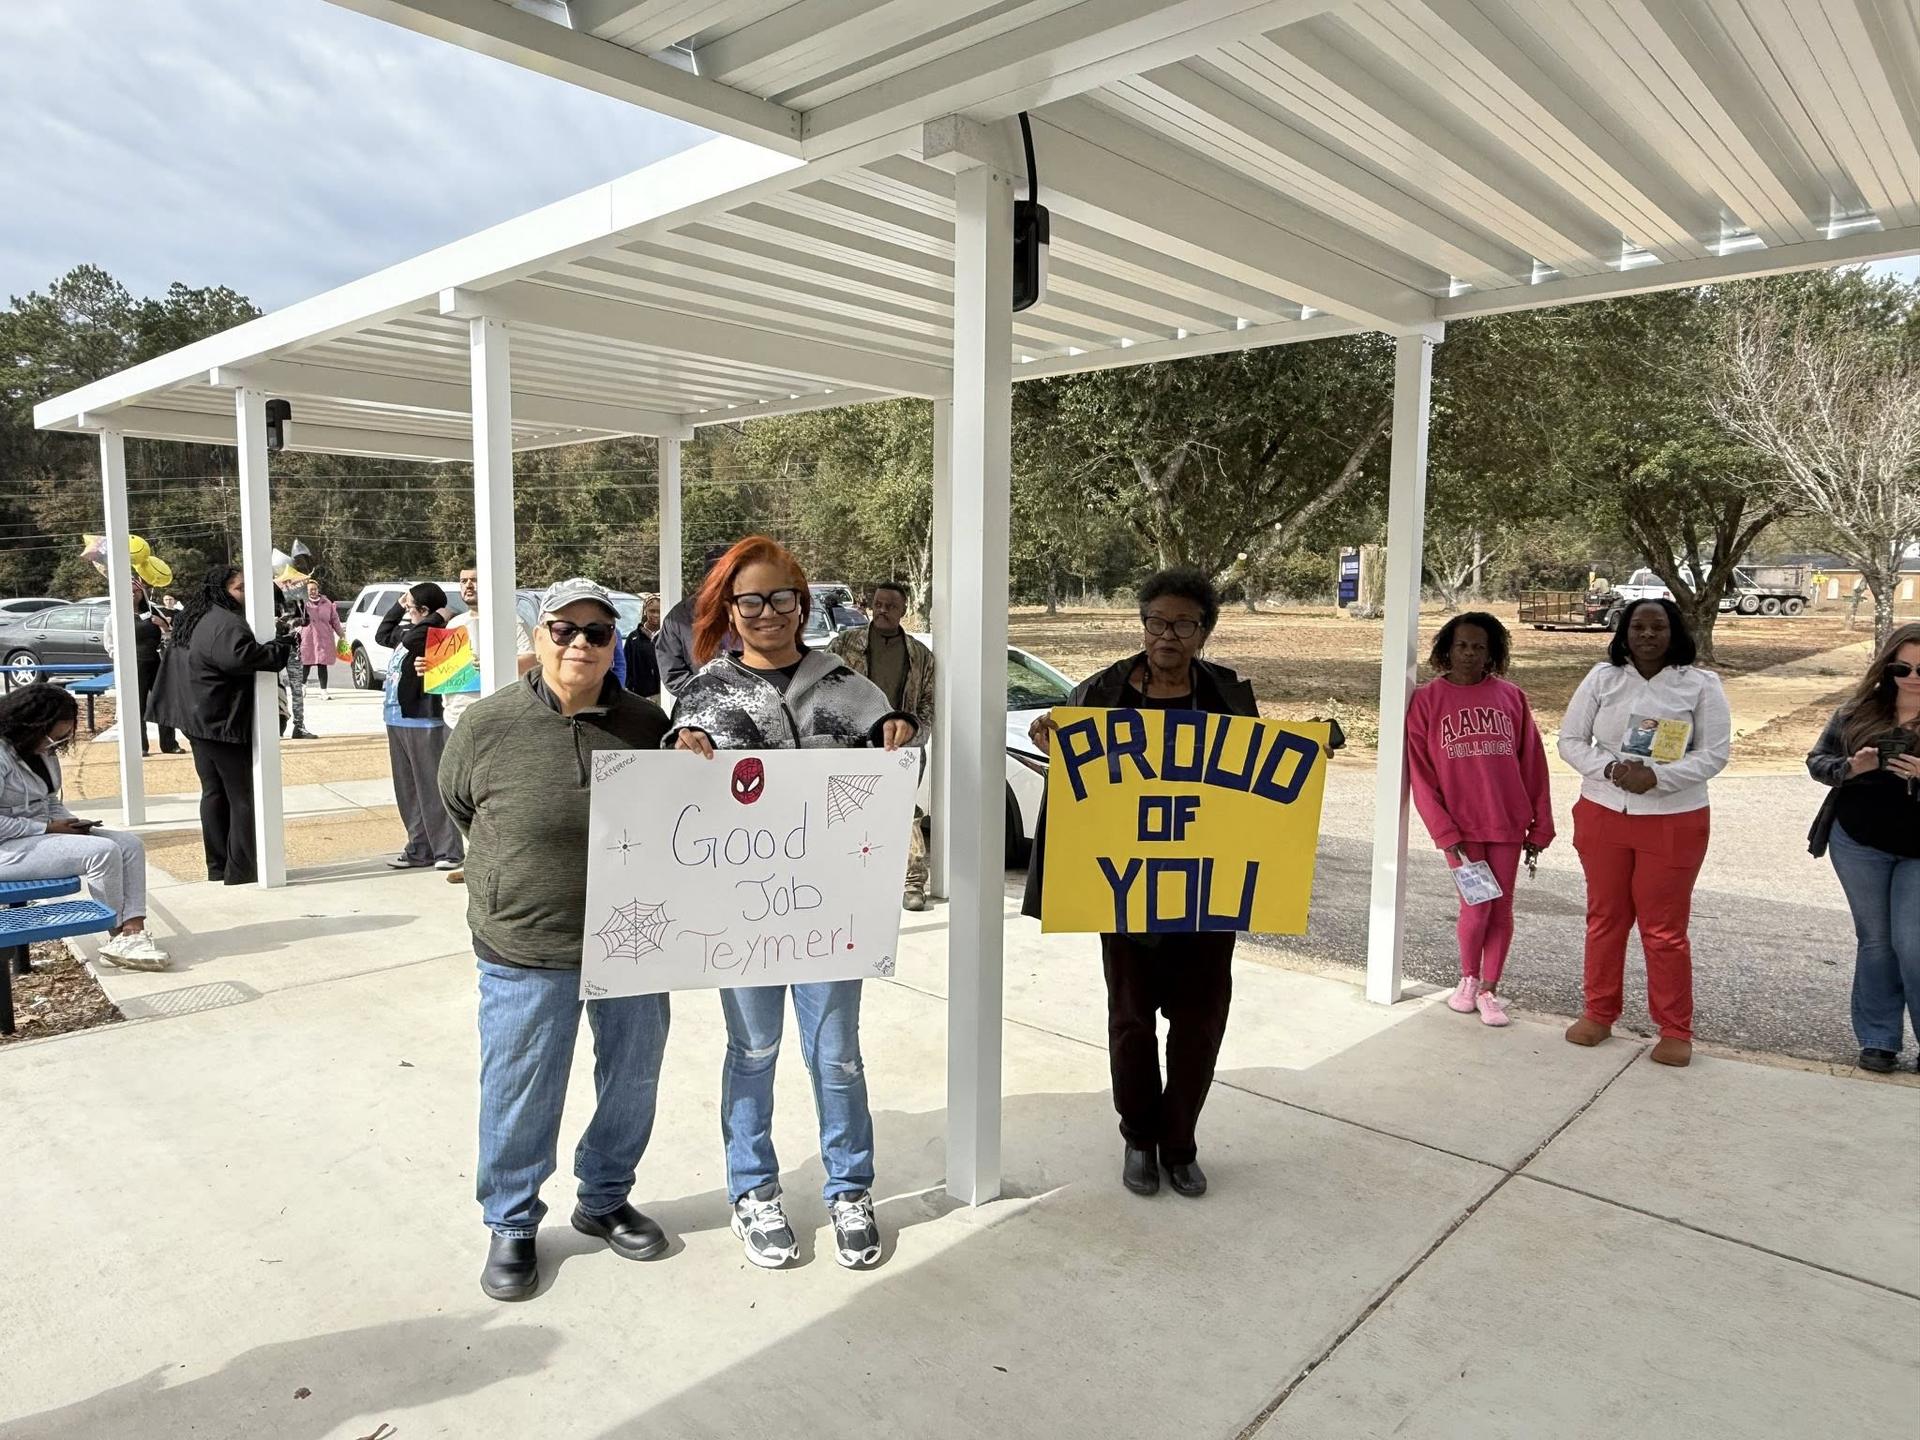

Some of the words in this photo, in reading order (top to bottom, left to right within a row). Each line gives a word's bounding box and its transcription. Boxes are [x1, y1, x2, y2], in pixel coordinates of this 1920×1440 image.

[1057, 708, 1320, 804] PROUD
[1441, 707, 1513, 748] AAMU
[1447, 740, 1513, 759] BULLDOGS
[673, 802, 808, 868] Good
[1137, 796, 1201, 842] OF
[1096, 857, 1260, 933] YOU
[676, 914, 855, 976] Teymer!
